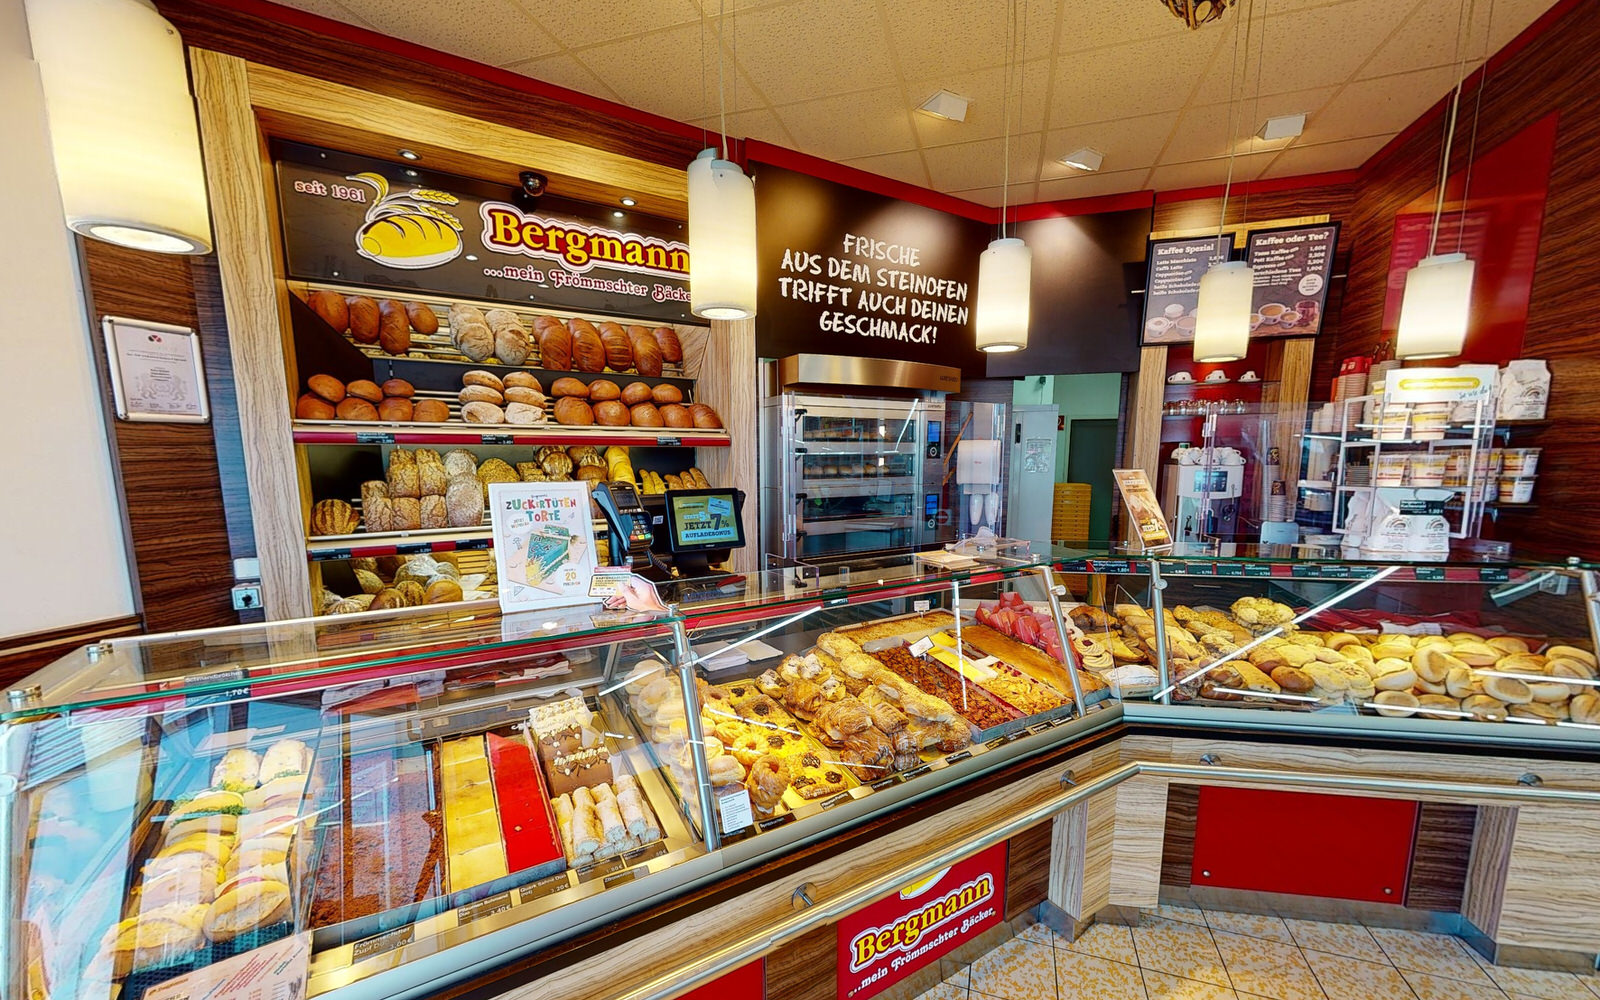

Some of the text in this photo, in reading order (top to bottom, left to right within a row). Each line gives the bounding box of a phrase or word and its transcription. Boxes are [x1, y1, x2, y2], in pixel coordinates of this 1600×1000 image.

[294, 180, 366, 202] seit 1961
[489, 209, 689, 274] Bergmann
[843, 233, 920, 267] FRISCHE
[1157, 243, 1214, 256] Kaffee Spezial
[1255, 231, 1329, 246] Kaffee oder Tee?
[484, 265, 691, 303] ...mein Frömmschter Bäcke
[781, 248, 968, 302] AUS DEM STEINOFEN
[778, 277, 968, 325] TRIFFT AUCH DEINEN
[819, 310, 938, 344] GESCHMACK!
[684, 521, 712, 530] JETZT
[685, 530, 731, 539] AUFLADEBONUS
[565, 571, 577, 581] 20
[855, 878, 990, 965] Bergmann
[891, 926, 959, 972] Frömmschter
